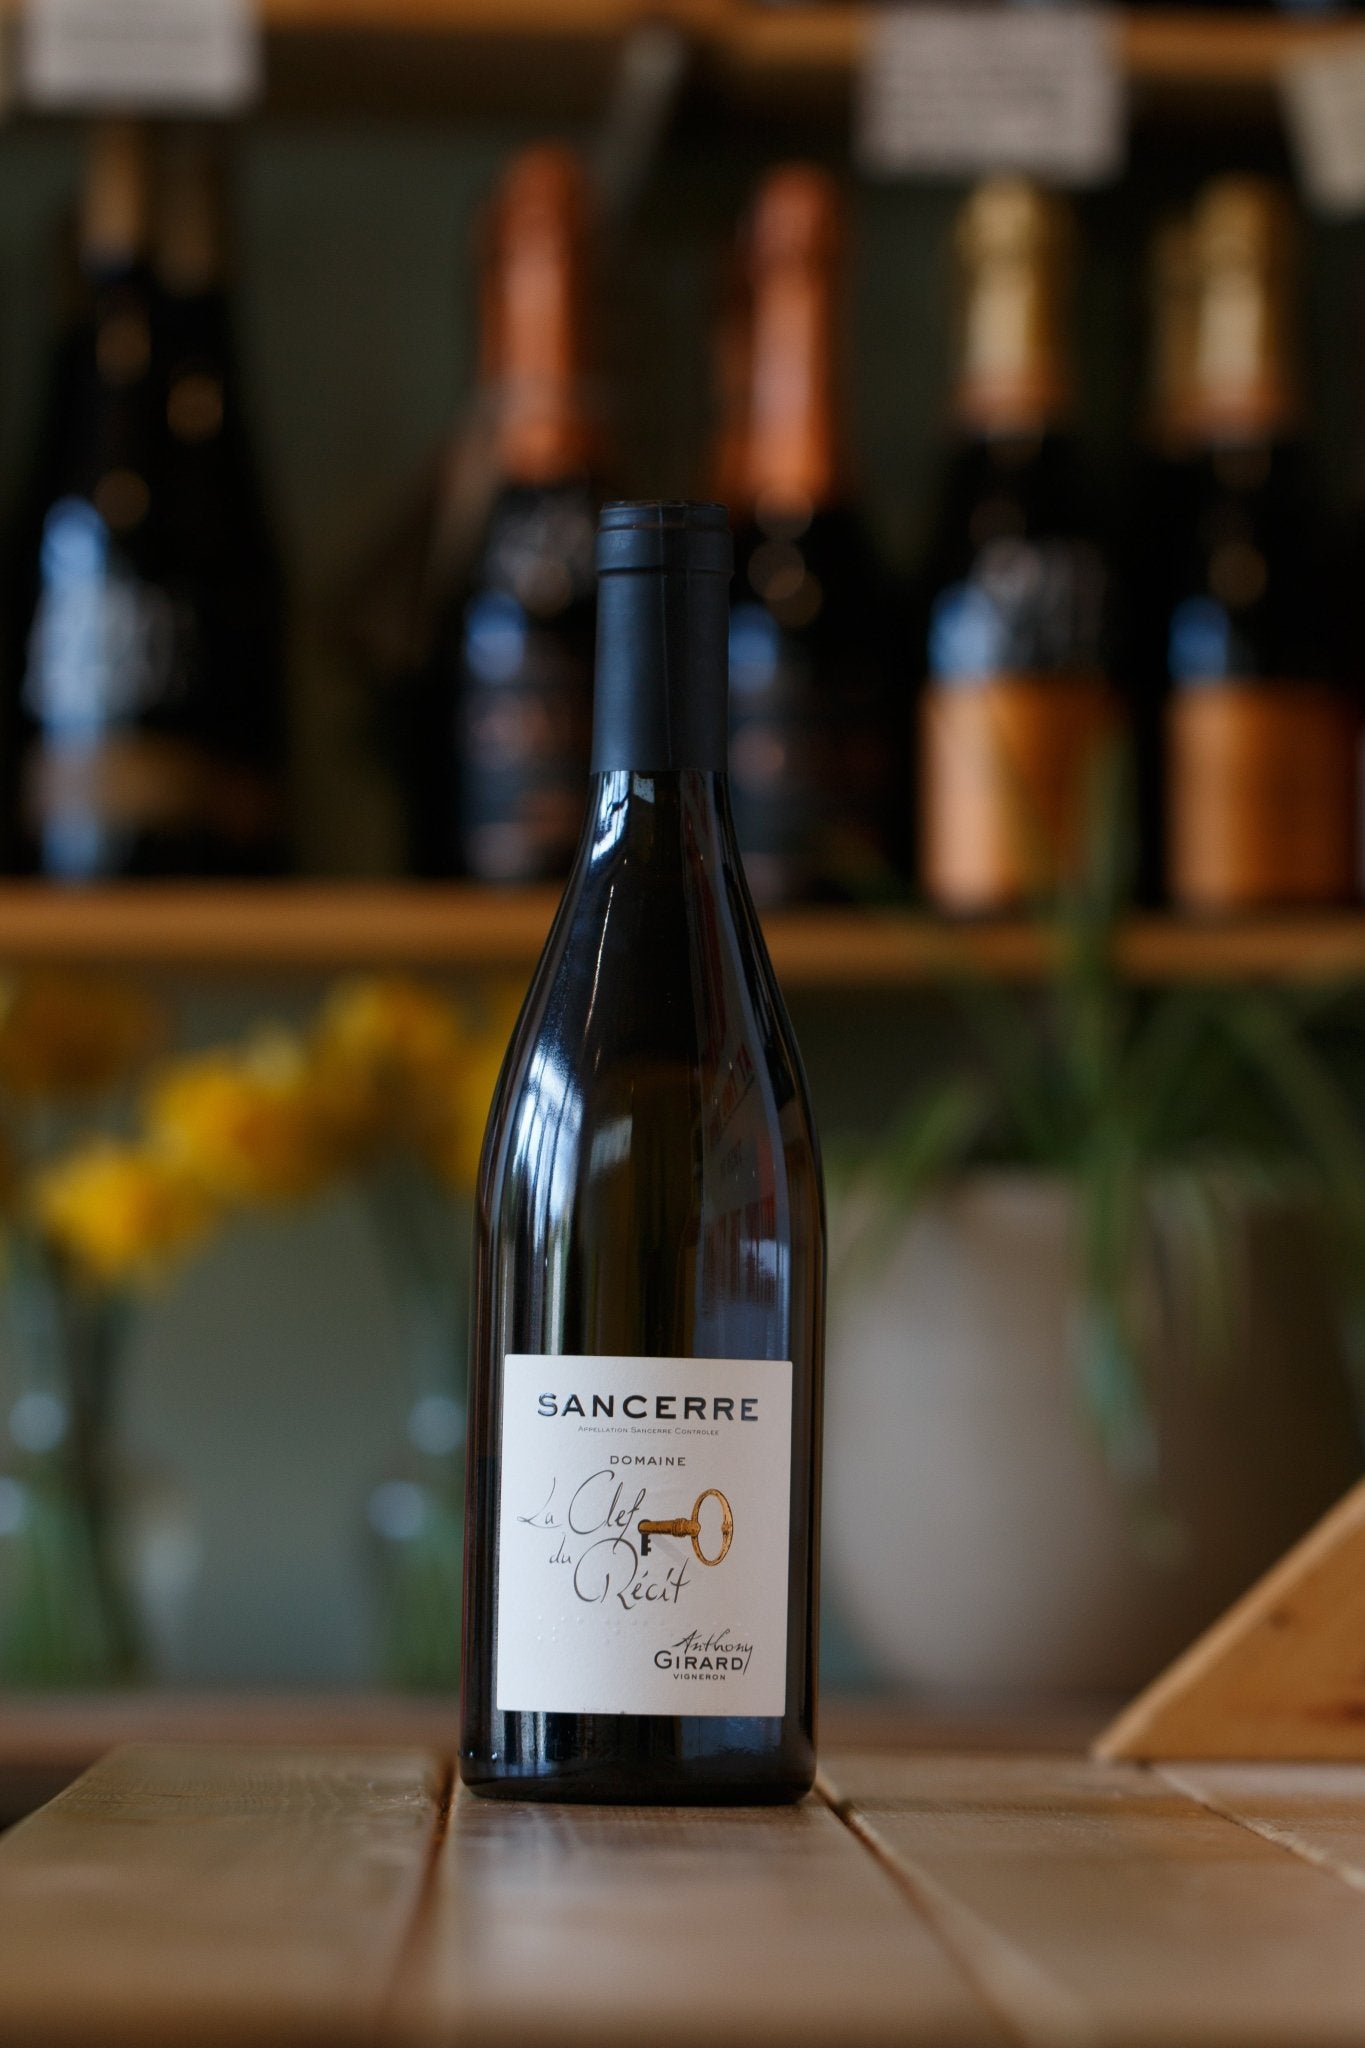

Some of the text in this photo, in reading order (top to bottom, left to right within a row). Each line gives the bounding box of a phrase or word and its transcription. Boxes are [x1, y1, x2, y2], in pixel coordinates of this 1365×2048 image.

[537, 1392, 759, 1422] SANCERRE
[609, 1455, 686, 1466] DOMAINE
[517, 1469, 647, 1555] La Clef
[549, 1532, 691, 1610] du Récit
[654, 1650, 743, 1670] GIRARD
[672, 1628, 753, 1675] Anthony
